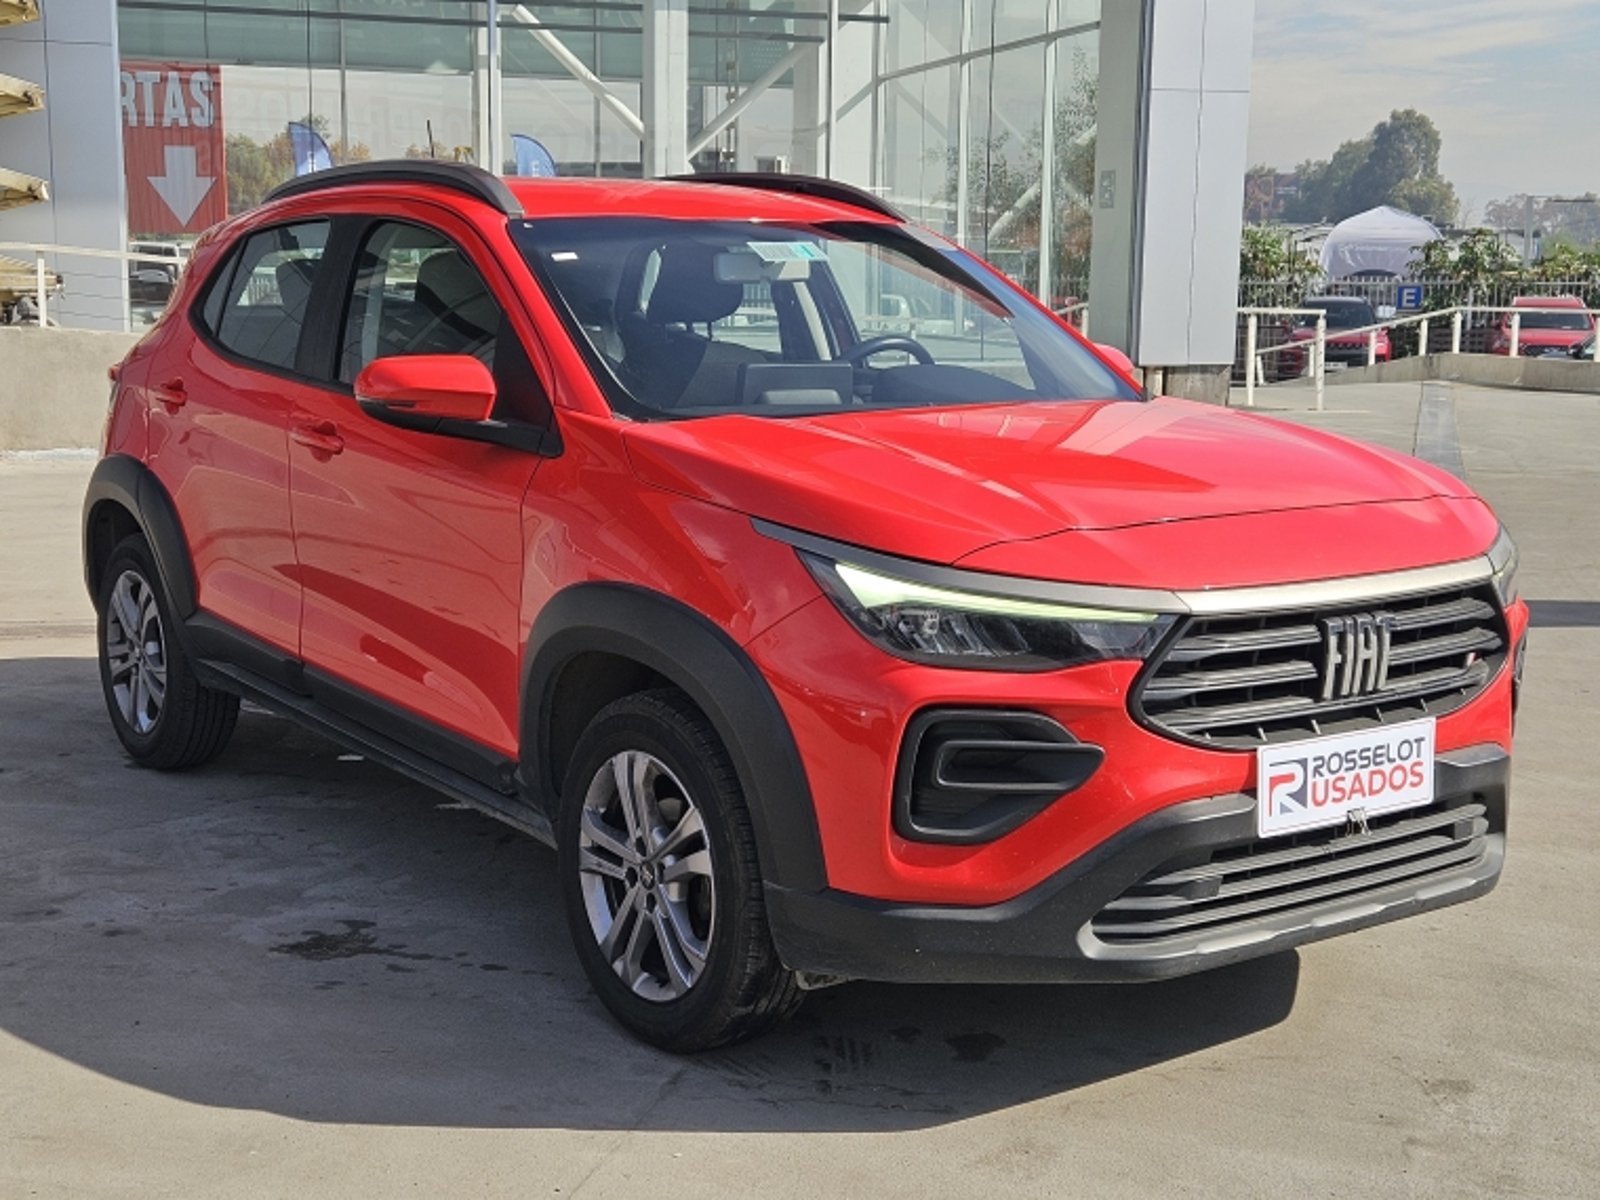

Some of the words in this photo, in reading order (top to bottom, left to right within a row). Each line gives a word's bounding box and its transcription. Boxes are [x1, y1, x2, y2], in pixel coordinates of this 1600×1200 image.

[1402, 288, 1417, 307] E
[1322, 611, 1398, 700] FIAT
[1312, 737, 1426, 778] ROSSELOT
[1311, 761, 1424, 808] USADOS
